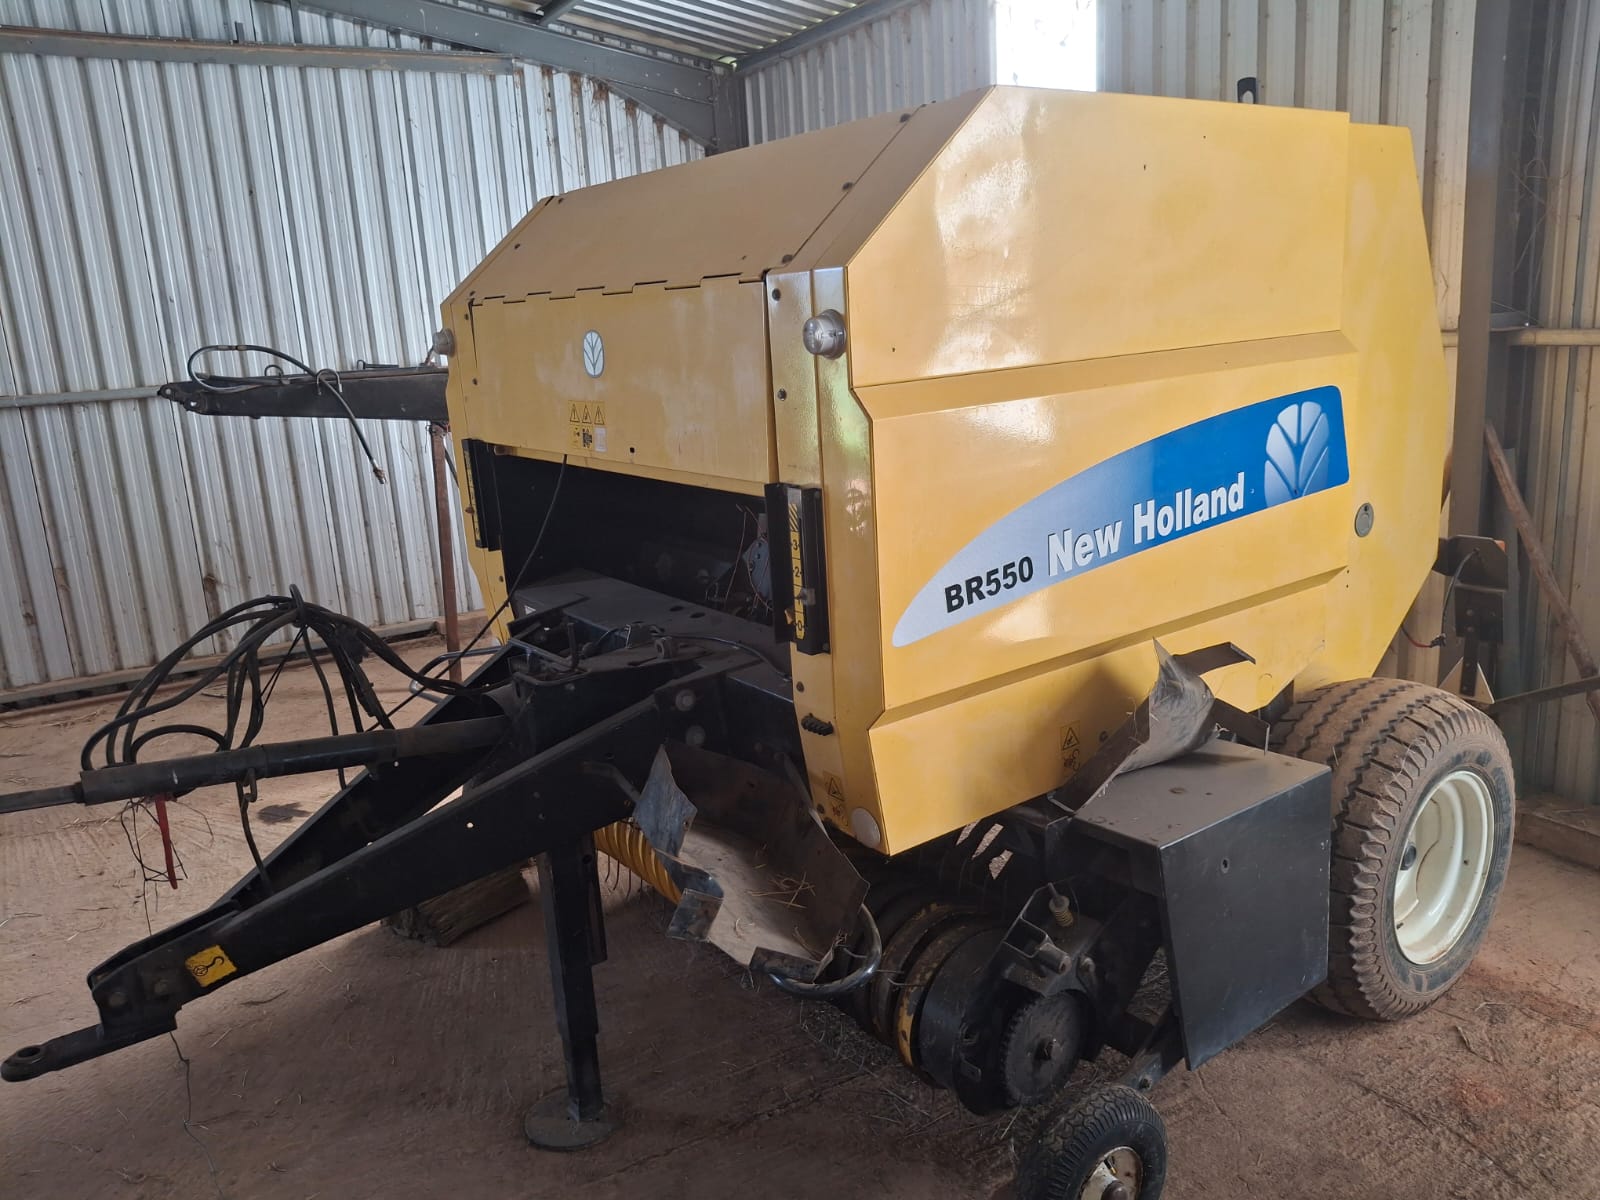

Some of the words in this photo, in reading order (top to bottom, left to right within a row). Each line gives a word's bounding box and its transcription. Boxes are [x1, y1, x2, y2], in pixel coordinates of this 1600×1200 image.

[944, 556, 1034, 614] BR550
[1048, 520, 1123, 577] New
[1132, 471, 1246, 545] Holland
